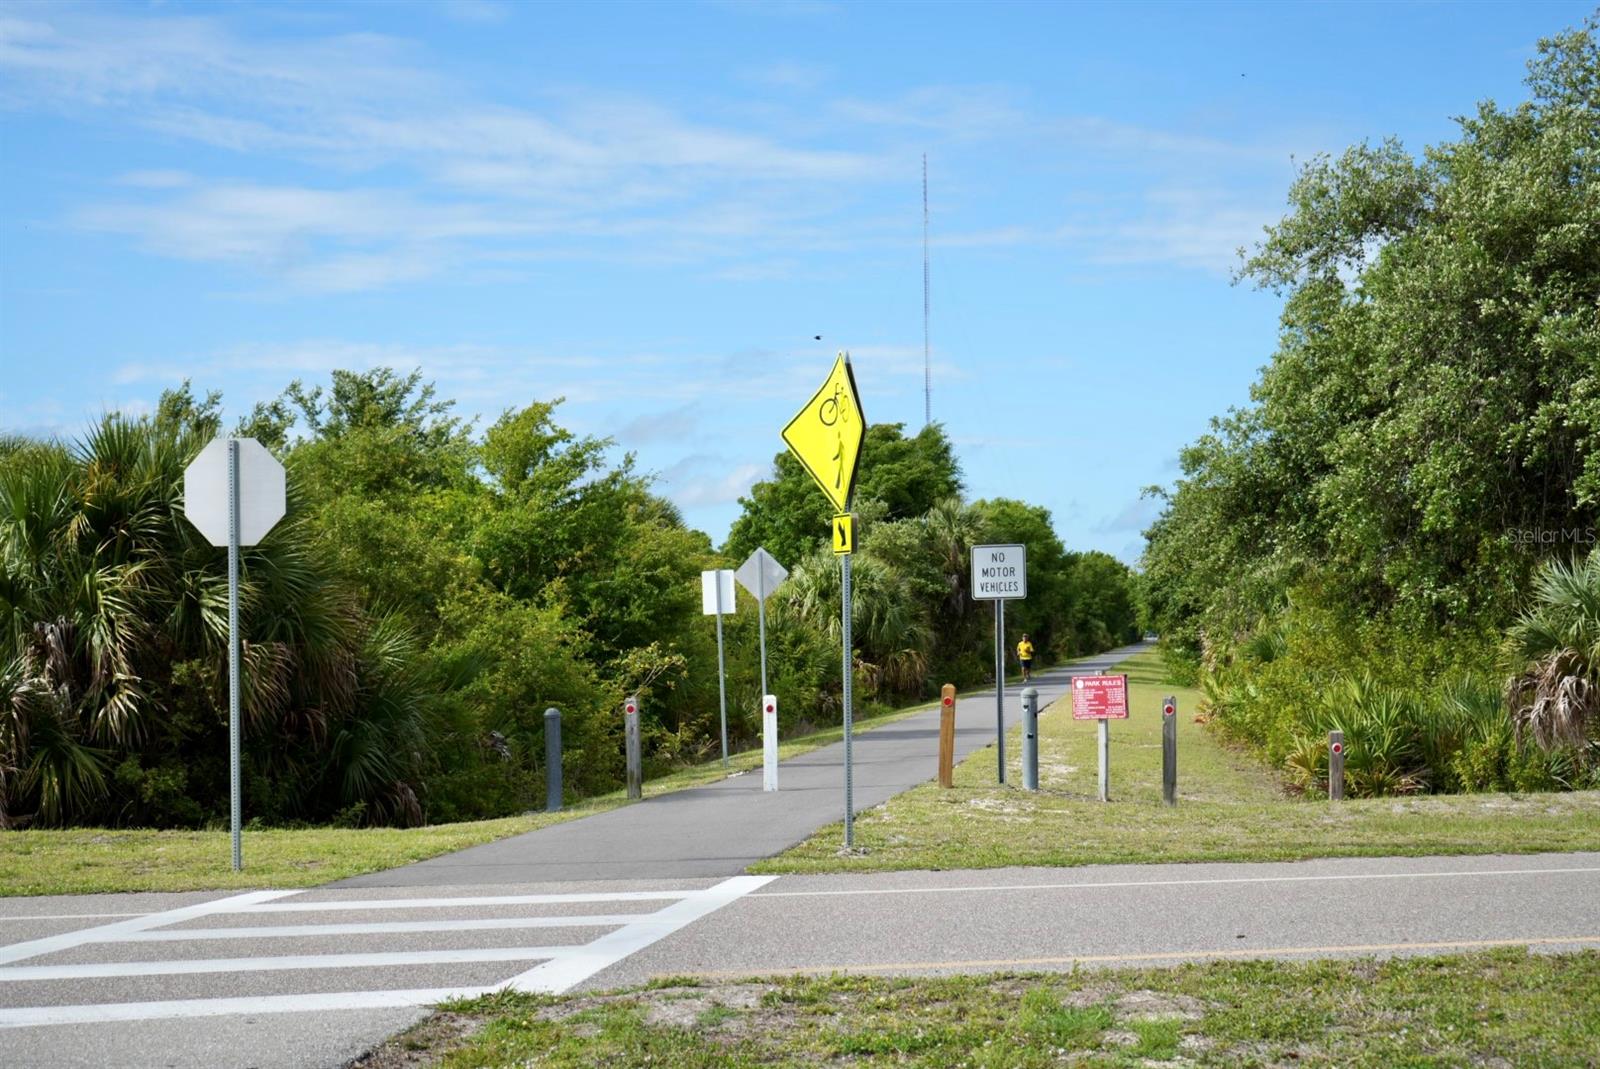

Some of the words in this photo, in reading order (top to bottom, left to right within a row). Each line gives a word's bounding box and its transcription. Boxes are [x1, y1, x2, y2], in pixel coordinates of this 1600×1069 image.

[991, 552, 1005, 563] NO
[981, 566, 1016, 578] MOTOR
[979, 581, 1019, 592] VEHICLES
